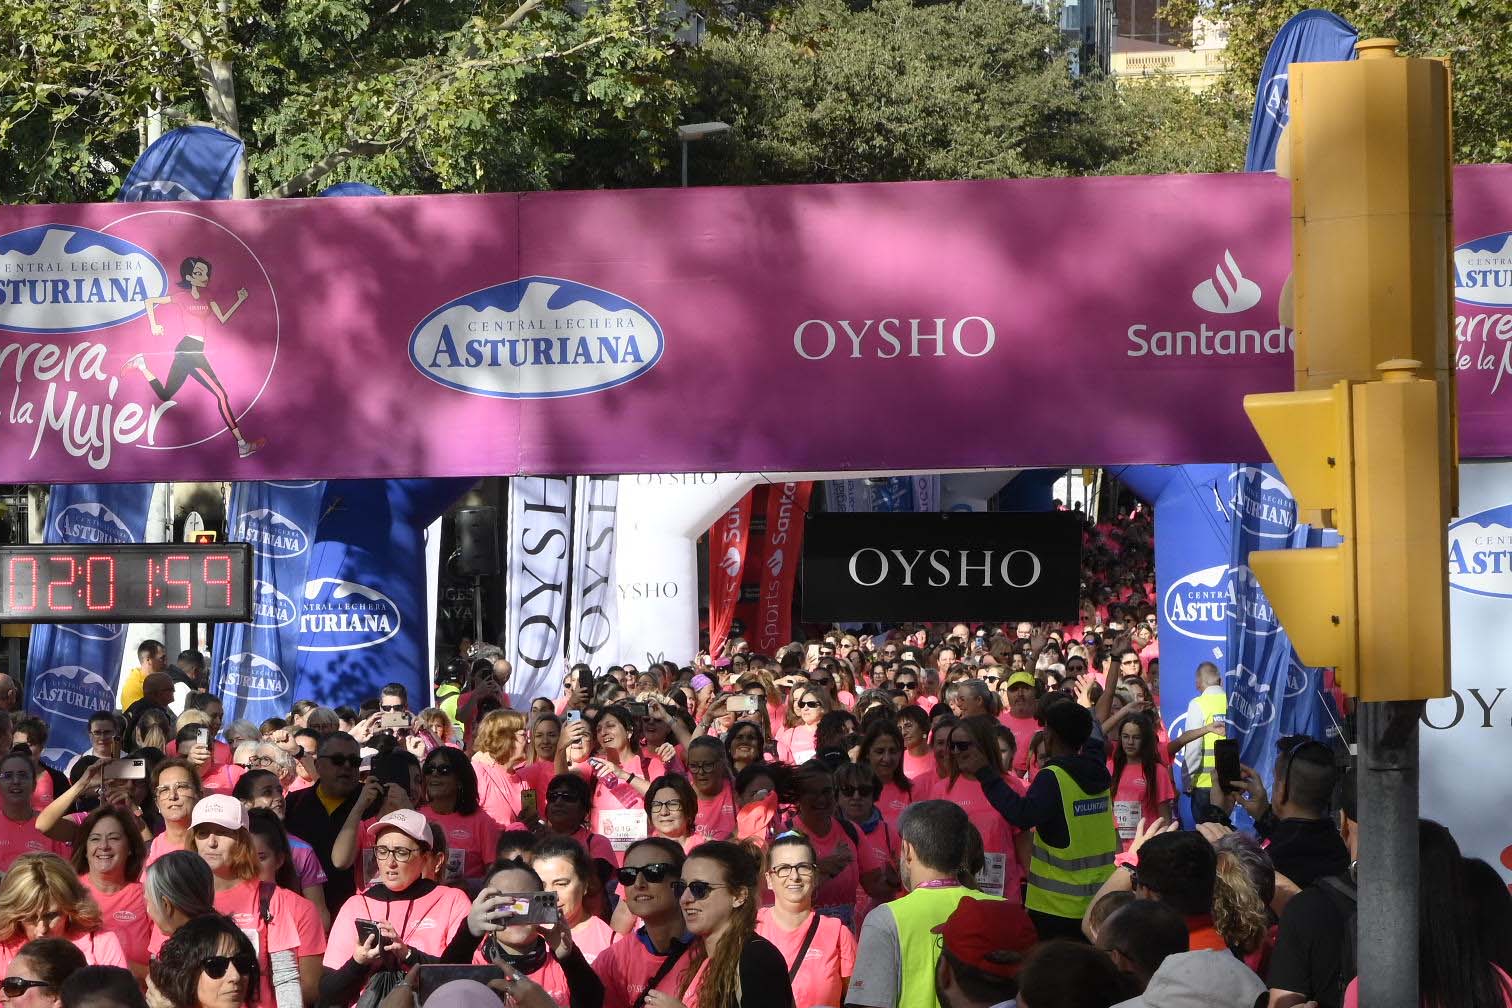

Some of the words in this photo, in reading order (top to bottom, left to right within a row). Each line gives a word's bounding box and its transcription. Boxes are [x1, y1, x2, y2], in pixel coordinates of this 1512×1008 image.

[71, 260, 143, 272] LECHERA
[468, 318, 546, 333] CENTRAL
[555, 316, 635, 331] LECHERA
[793, 316, 996, 360] OYSHO
[1455, 313, 1512, 342] arre
[429, 324, 645, 369] ASTURIANA
[1127, 323, 1294, 357] Santand
[1477, 342, 1495, 370] la
[9, 384, 34, 424] la
[28, 376, 178, 470] Mujer
[238, 522, 299, 551] ASTRIANA
[848, 547, 1041, 588] OYSHO
[617, 581, 678, 599] YSHO
[302, 603, 333, 611] NTRAL
[300, 615, 391, 632] TURIANA
[36, 681, 110, 712] ASTURIANA
[1420, 688, 1512, 730] OY
